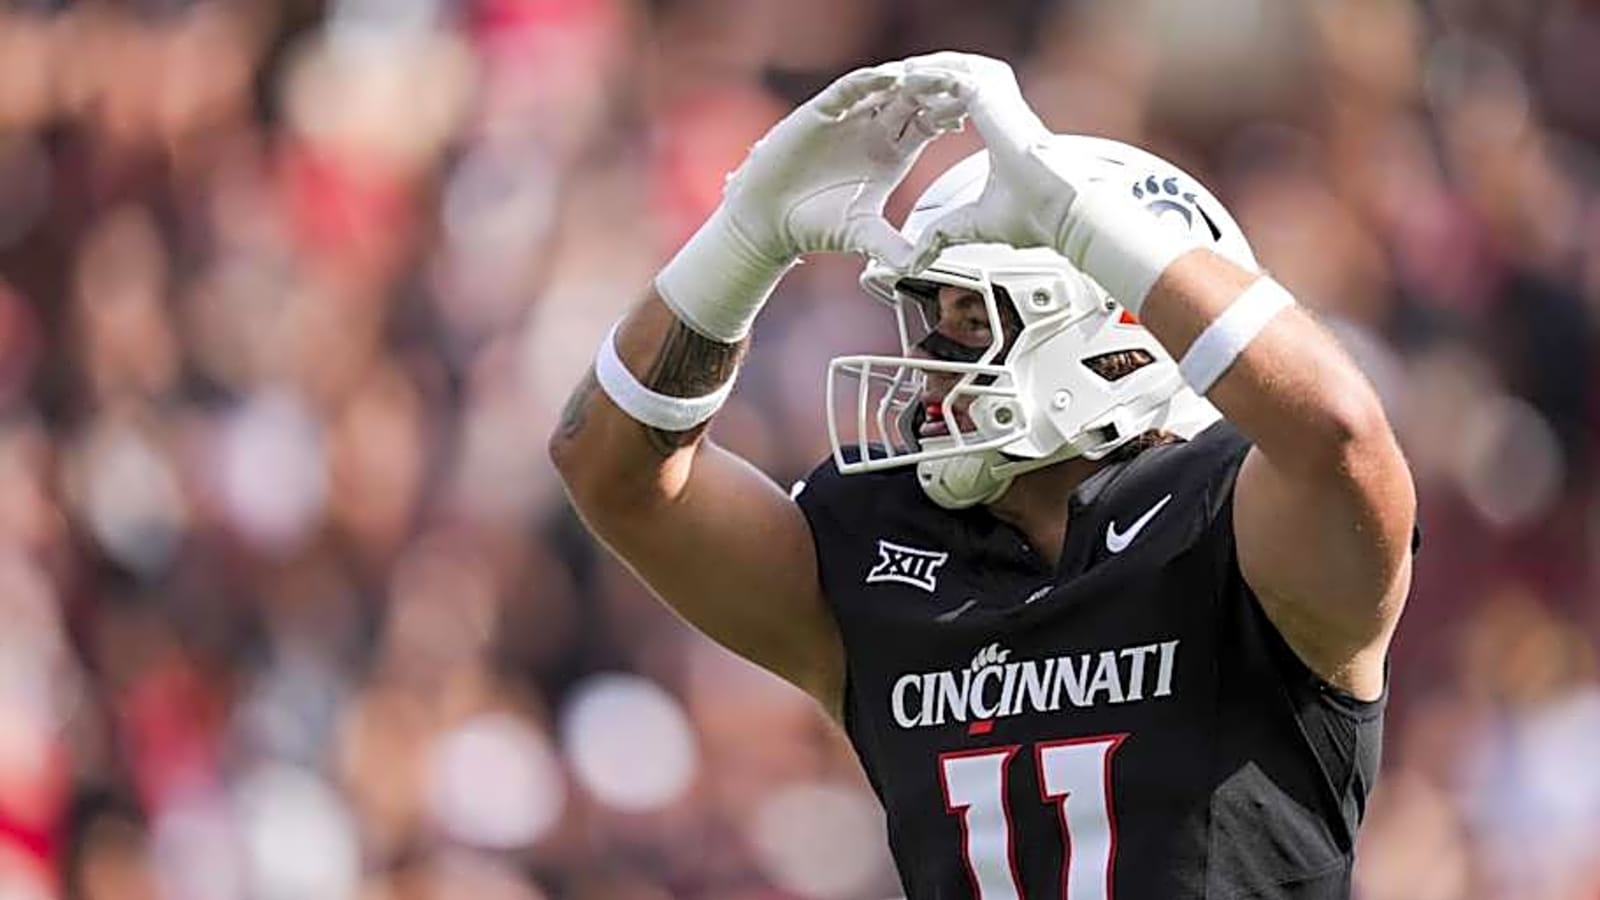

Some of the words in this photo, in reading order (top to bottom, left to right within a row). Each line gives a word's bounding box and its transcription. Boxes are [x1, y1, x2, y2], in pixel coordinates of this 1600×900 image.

[867, 540, 948, 592] XII
[892, 641, 1179, 728] CINCINNATI
[939, 733, 1129, 900] 11
